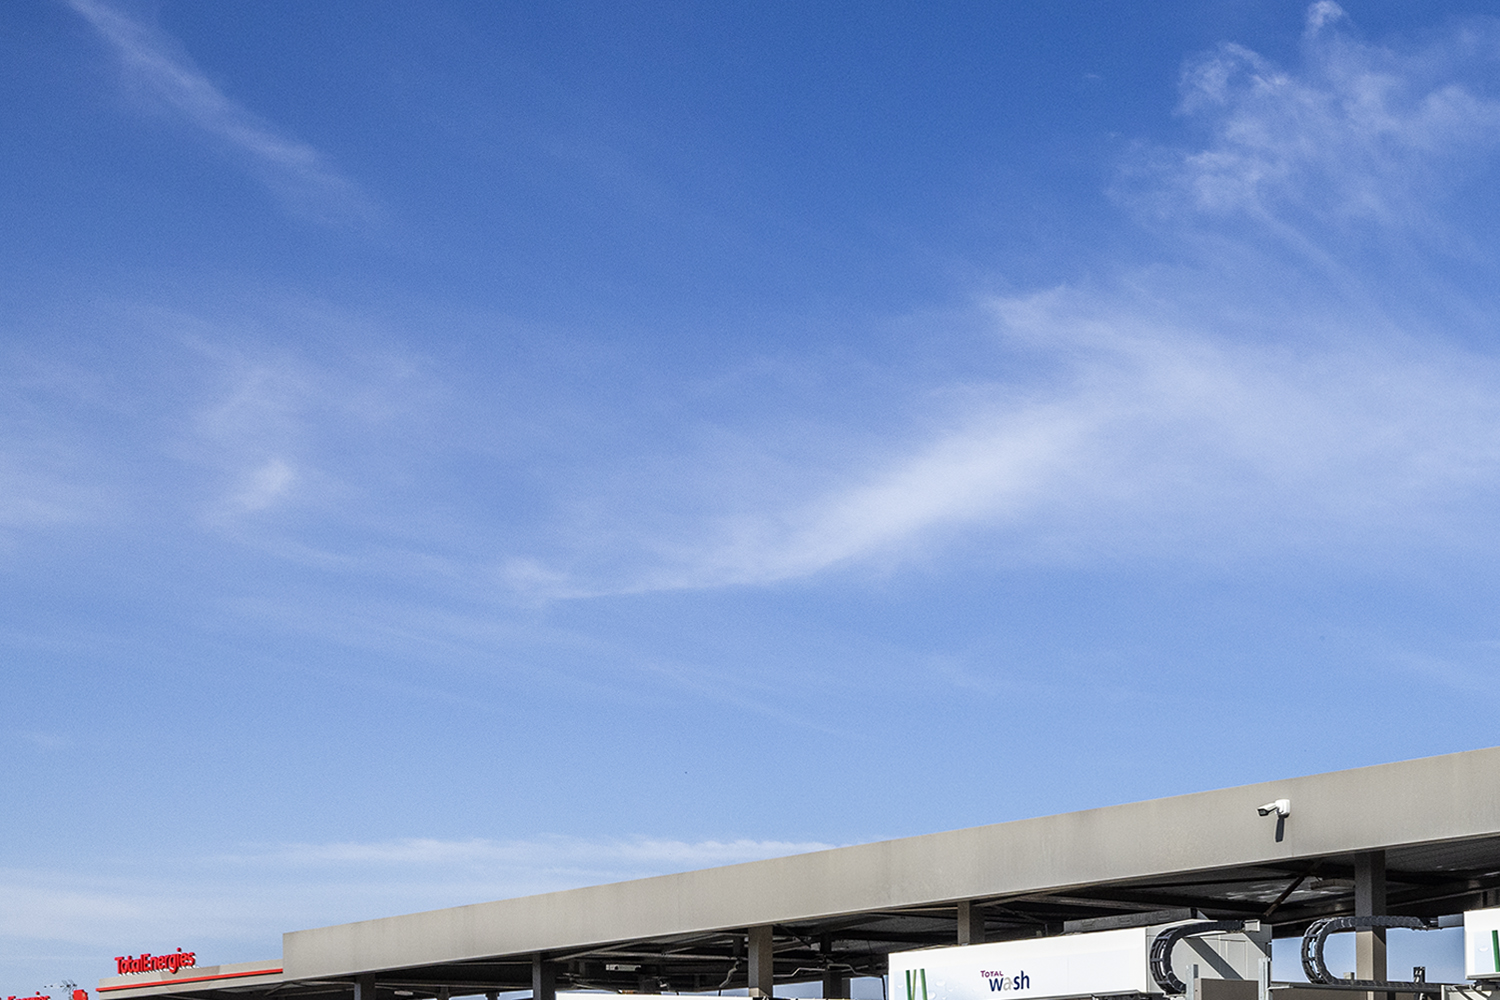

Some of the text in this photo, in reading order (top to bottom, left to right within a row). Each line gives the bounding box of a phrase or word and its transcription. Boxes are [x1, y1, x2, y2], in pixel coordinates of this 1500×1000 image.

[114, 947, 196, 974] TotalEnergies
[980, 970, 1004, 978] TOTAL
[989, 970, 1030, 992] wash
